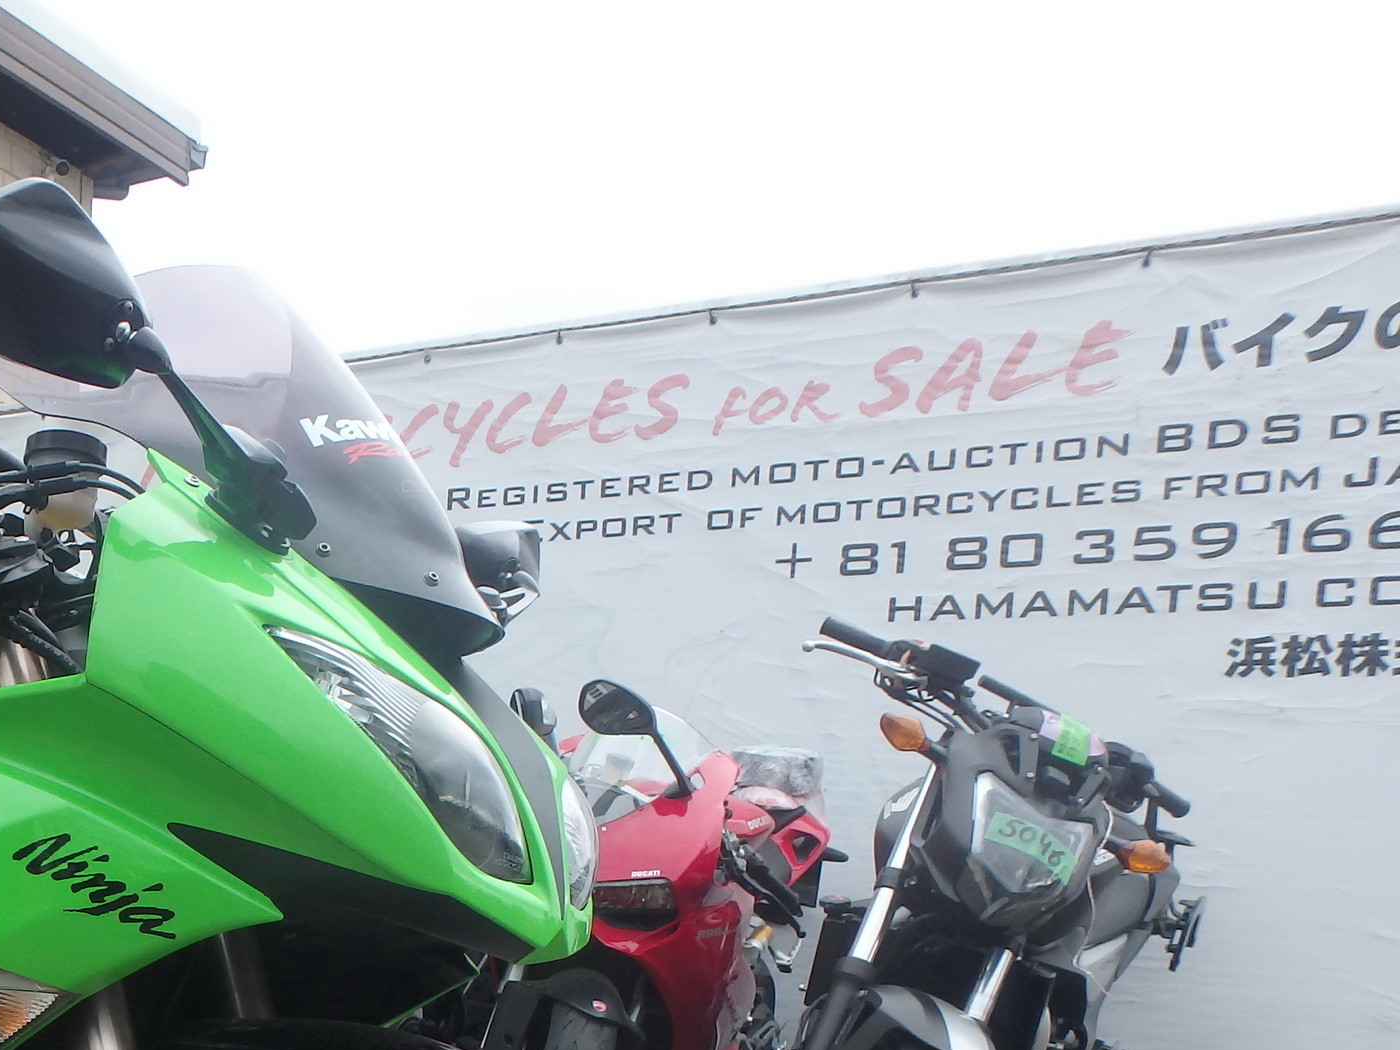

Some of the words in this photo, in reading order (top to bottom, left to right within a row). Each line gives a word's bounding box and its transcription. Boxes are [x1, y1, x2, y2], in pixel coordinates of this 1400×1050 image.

[858, 319, 1134, 419] SALE
[446, 469, 714, 511] REGISTERED
[730, 433, 1131, 488] MOTO-AUCTION
[1155, 412, 1303, 454] BDS
[706, 497, 764, 532] OF
[775, 479, 1142, 527] MOTORCYCLES
[1162, 465, 1323, 501] FROM
[838, 540, 908, 577] 81
[944, 532, 1045, 572] 80
[1071, 520, 1238, 566] 359
[886, 577, 1290, 625] HAMAMATSU
[1224, 632, 1400, 678] 浜松株
[12, 833, 177, 940] Ninja
[630, 869, 662, 878] DUCATI
